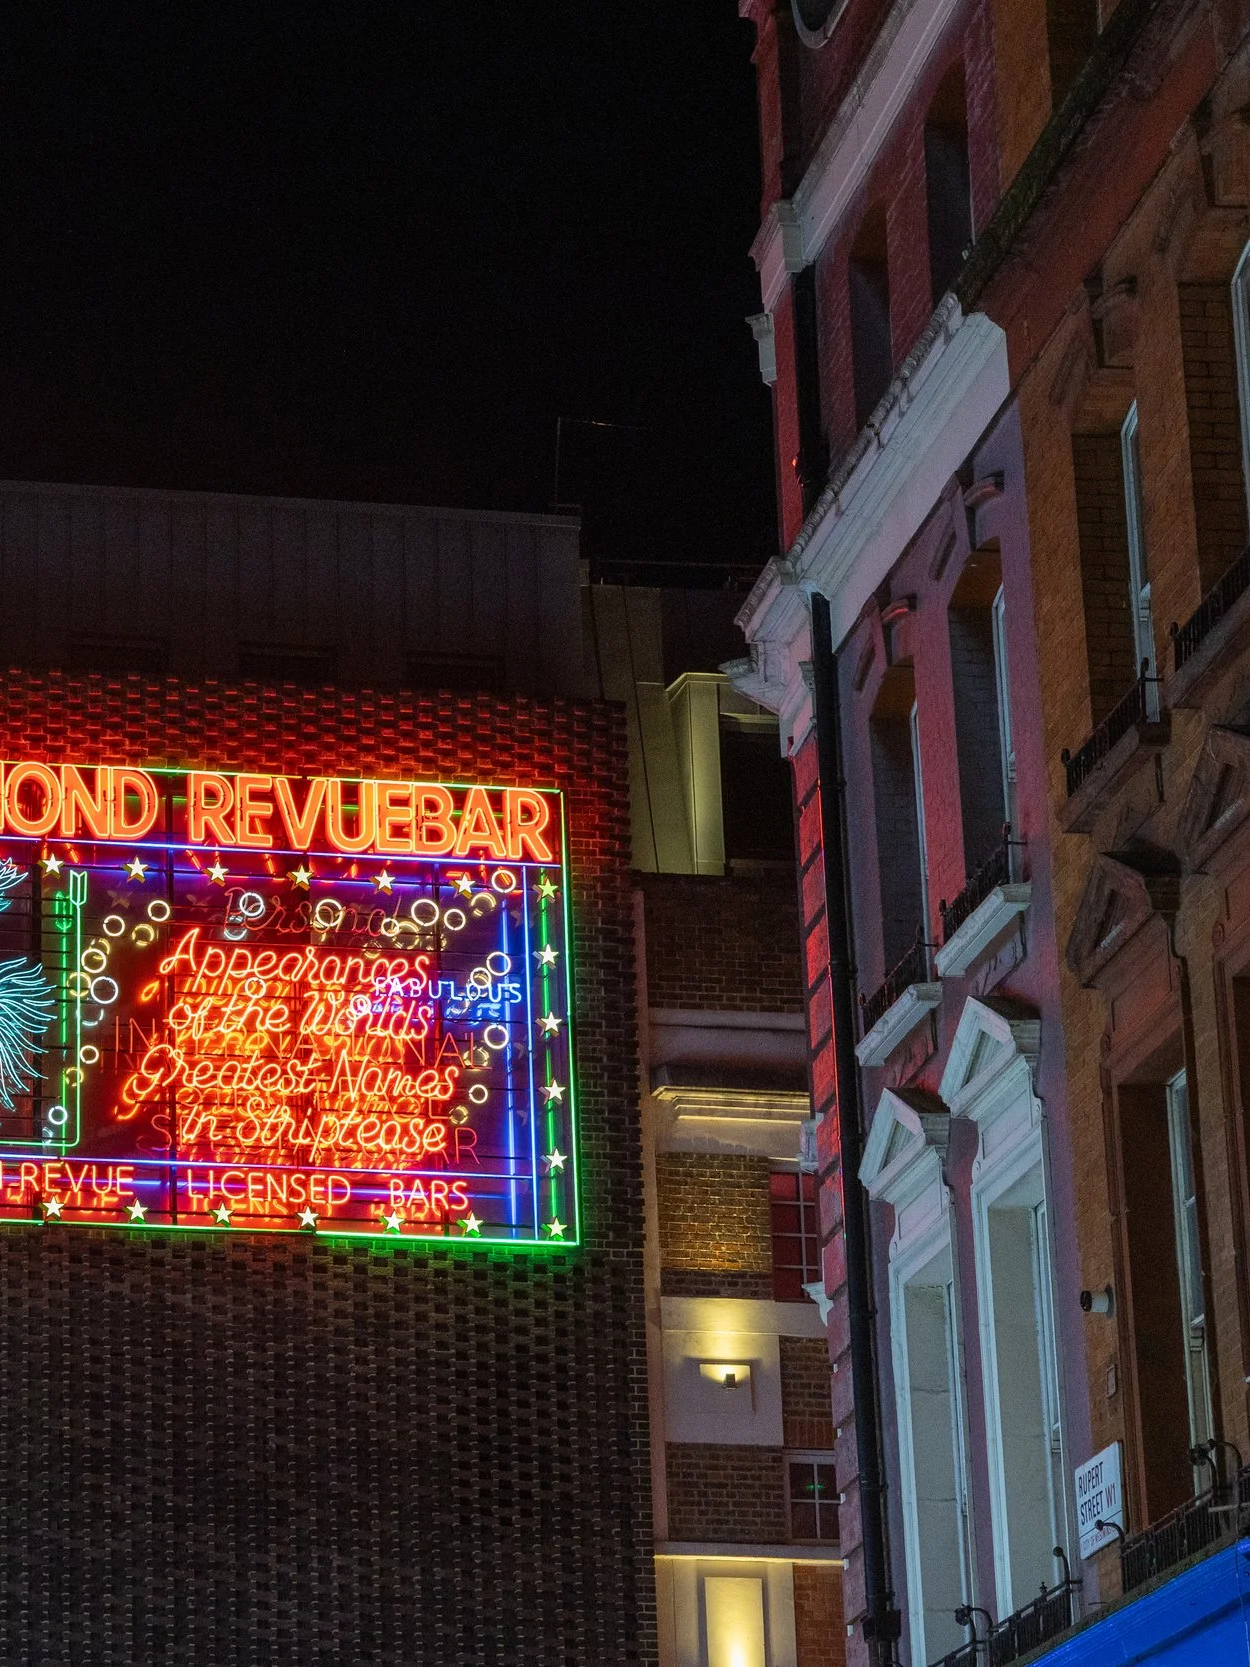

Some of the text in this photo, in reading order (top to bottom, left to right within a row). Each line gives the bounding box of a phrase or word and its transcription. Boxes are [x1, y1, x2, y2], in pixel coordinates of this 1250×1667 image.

[188, 772, 552, 862] REVUEBAR
[224, 887, 402, 937] Personal
[159, 928, 430, 996] Appearances
[375, 976, 523, 1004] FABULOUS
[168, 996, 213, 1040] of
[219, 994, 292, 1034] the
[132, 1043, 459, 1103] Greatest Names
[236, 1096, 447, 1163] Striptease
[19, 1162, 135, 1196] REVUE
[187, 1168, 351, 1205] LICENSED
[389, 1178, 469, 1211] BARS
[1078, 1461, 1104, 1498] RUPERT
[1080, 1482, 1117, 1526] STREET W1
